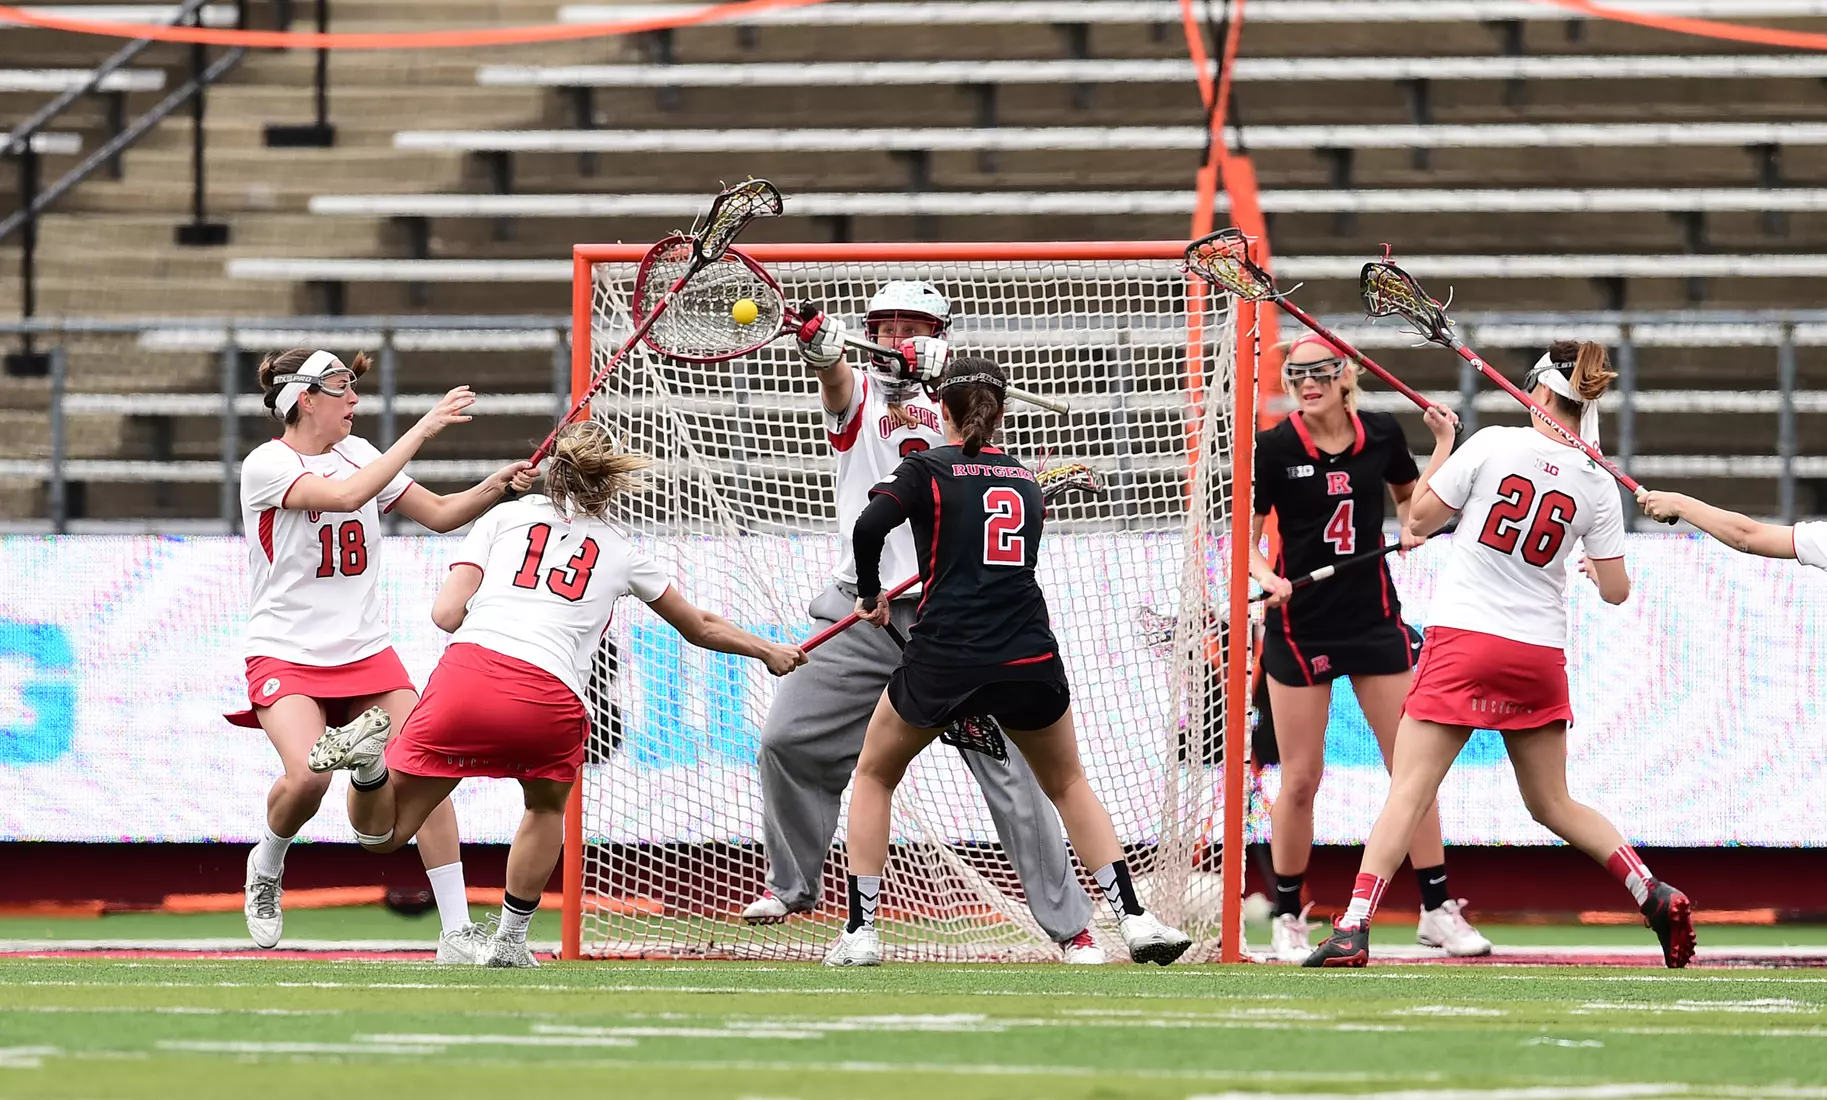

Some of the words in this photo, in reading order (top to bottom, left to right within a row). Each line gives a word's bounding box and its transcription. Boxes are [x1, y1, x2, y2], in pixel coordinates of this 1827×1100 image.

[952, 464, 1036, 483] RUTGERS
[1326, 471, 1353, 495] R
[316, 519, 368, 578] 18
[983, 487, 1025, 566] 2
[1324, 500, 1356, 555] 4
[1477, 473, 1577, 568] 26
[512, 522, 600, 602] 13
